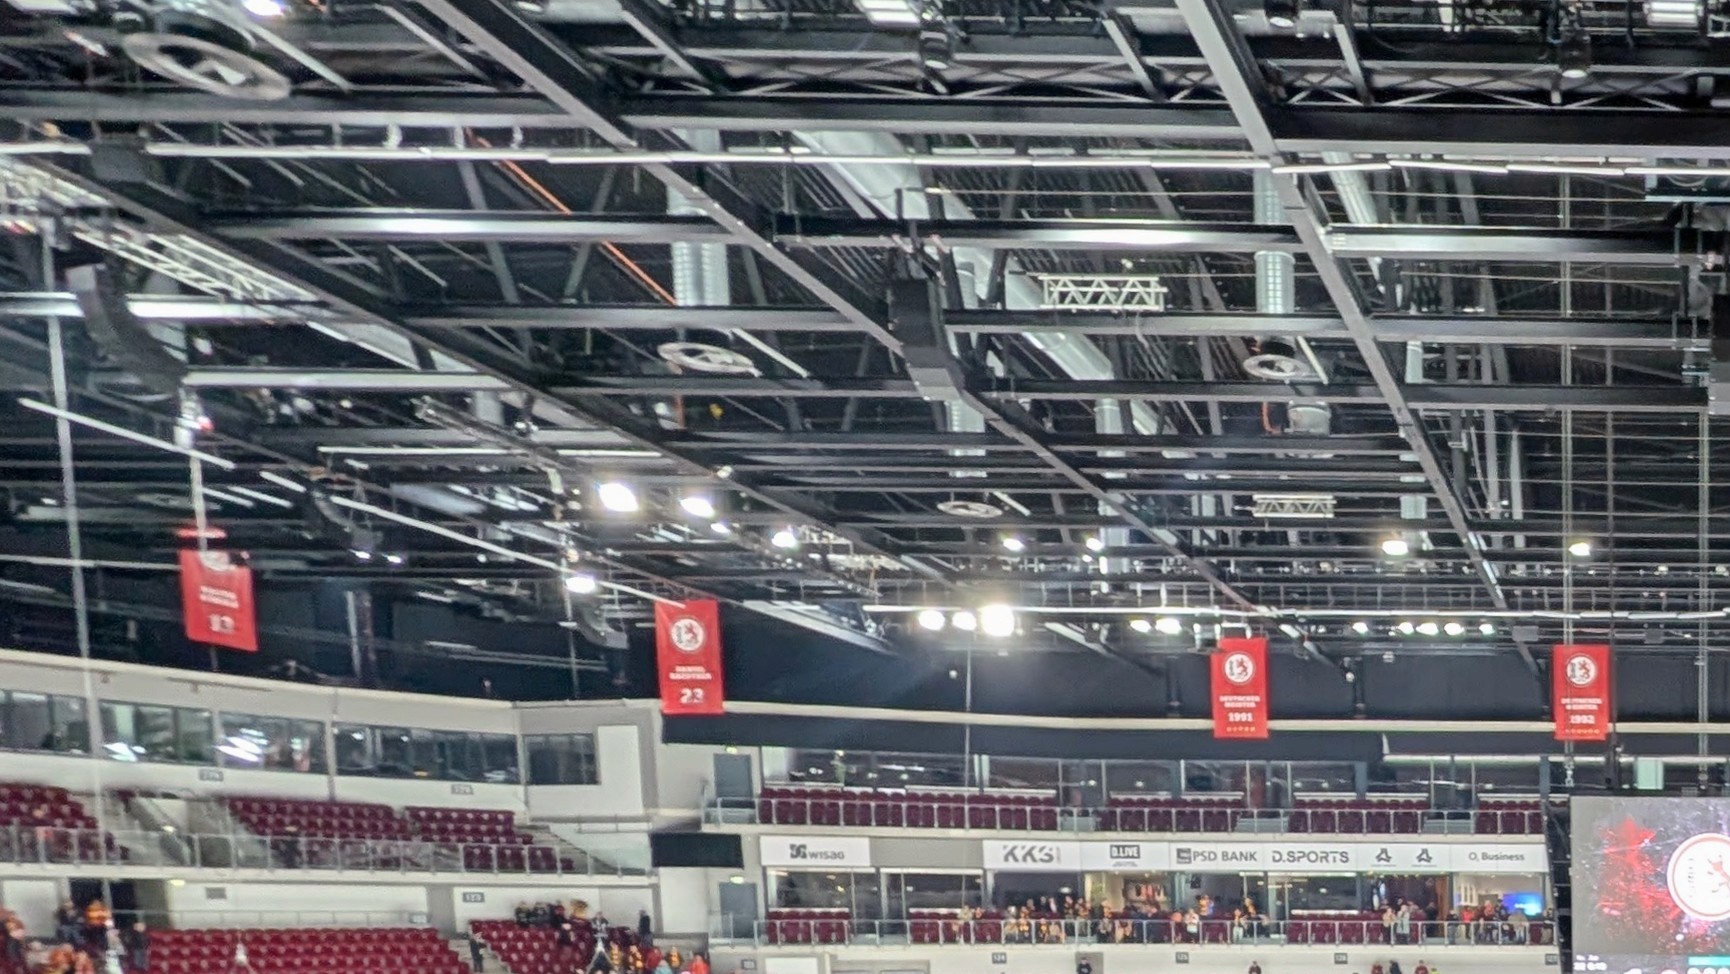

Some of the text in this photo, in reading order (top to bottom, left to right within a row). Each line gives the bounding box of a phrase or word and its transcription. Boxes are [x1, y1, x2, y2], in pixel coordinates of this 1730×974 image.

[1228, 712, 1253, 722] 1991
[1002, 845, 1053, 863] KKS
[1193, 850, 1217, 862] PSD
[1221, 850, 1257, 862] BANK
[1271, 850, 1349, 863] D.SPORTS
[1481, 852, 1525, 861] Business
